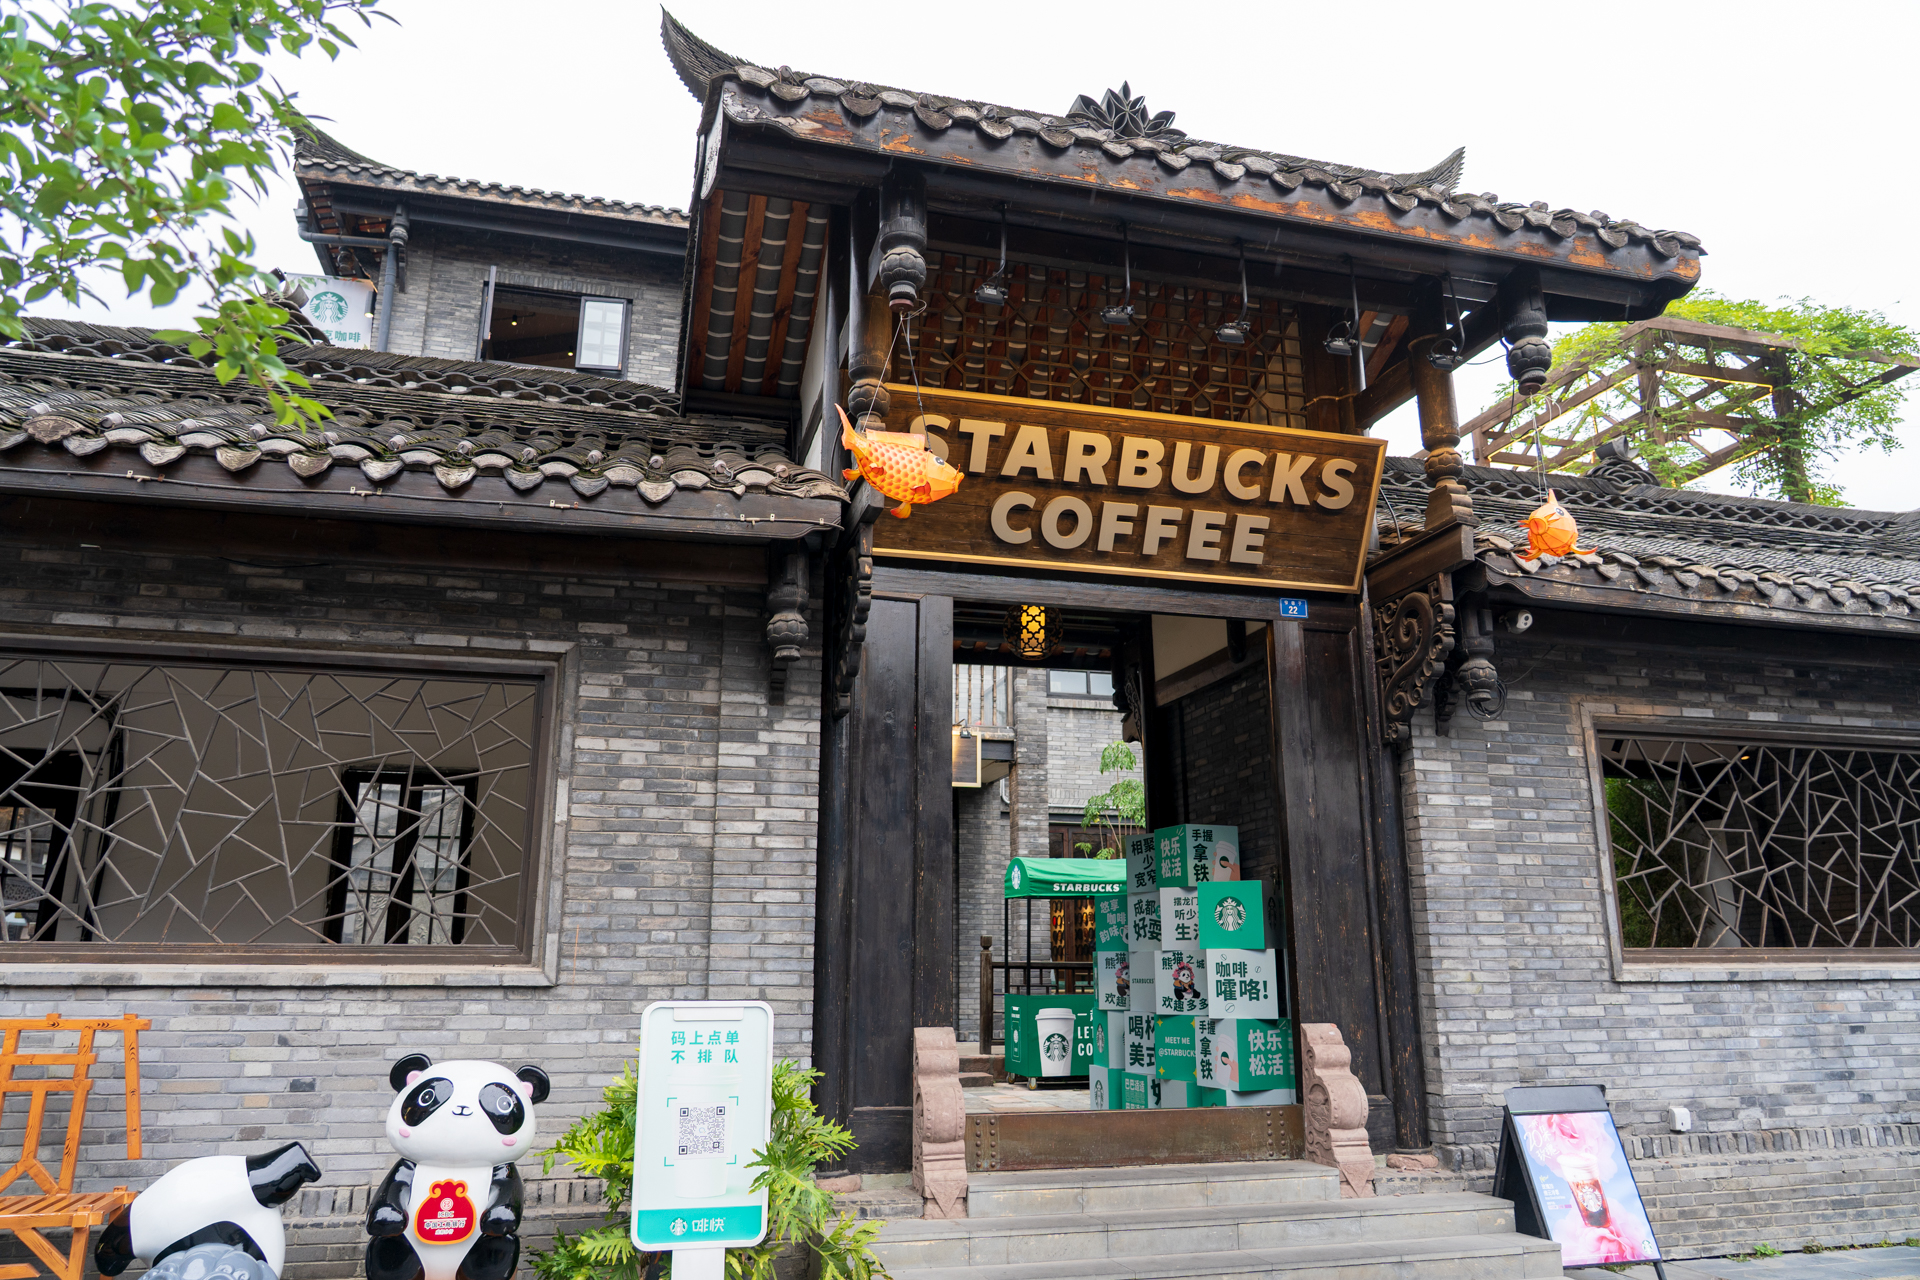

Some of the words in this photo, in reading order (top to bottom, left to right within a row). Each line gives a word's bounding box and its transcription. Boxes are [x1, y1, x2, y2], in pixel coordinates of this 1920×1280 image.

[909, 414, 1358, 510] STARBUCKS
[990, 491, 1271, 565] COFFEE
[1288, 606, 1298, 614] 22
[1192, 829, 1213, 842] 手握
[1131, 837, 1155, 856] 相聚
[1161, 836, 1181, 858] 快乐
[1161, 858, 1182, 879] 松活
[1193, 843, 1210, 882] 拿铁
[1135, 869, 1157, 888] 宽窄
[1053, 883, 1120, 892] STARBUCKS
[1100, 899, 1119, 913] 悠享
[1134, 899, 1156, 917] 成都
[1107, 912, 1126, 925] 咖啡
[1174, 909, 1199, 920] 听少
[1099, 925, 1119, 943] 韵味
[1105, 953, 1126, 970] 熊猫
[1162, 952, 1205, 970] 熊猫之城
[1216, 961, 1248, 977] 咖啡
[1105, 993, 1129, 1008] 欢趣
[1162, 996, 1208, 1012] 欢趣多多
[1199, 1020, 1216, 1035] 手握
[671, 1030, 739, 1046] 码上点单
[1165, 1036, 1180, 1044] MEET
[1248, 1029, 1282, 1052] 快乐
[671, 1049, 738, 1064] 不排队
[1200, 1036, 1213, 1080] 拿铁
[1249, 1053, 1283, 1076] 松活
[691, 1217, 724, 1232] 啡快
